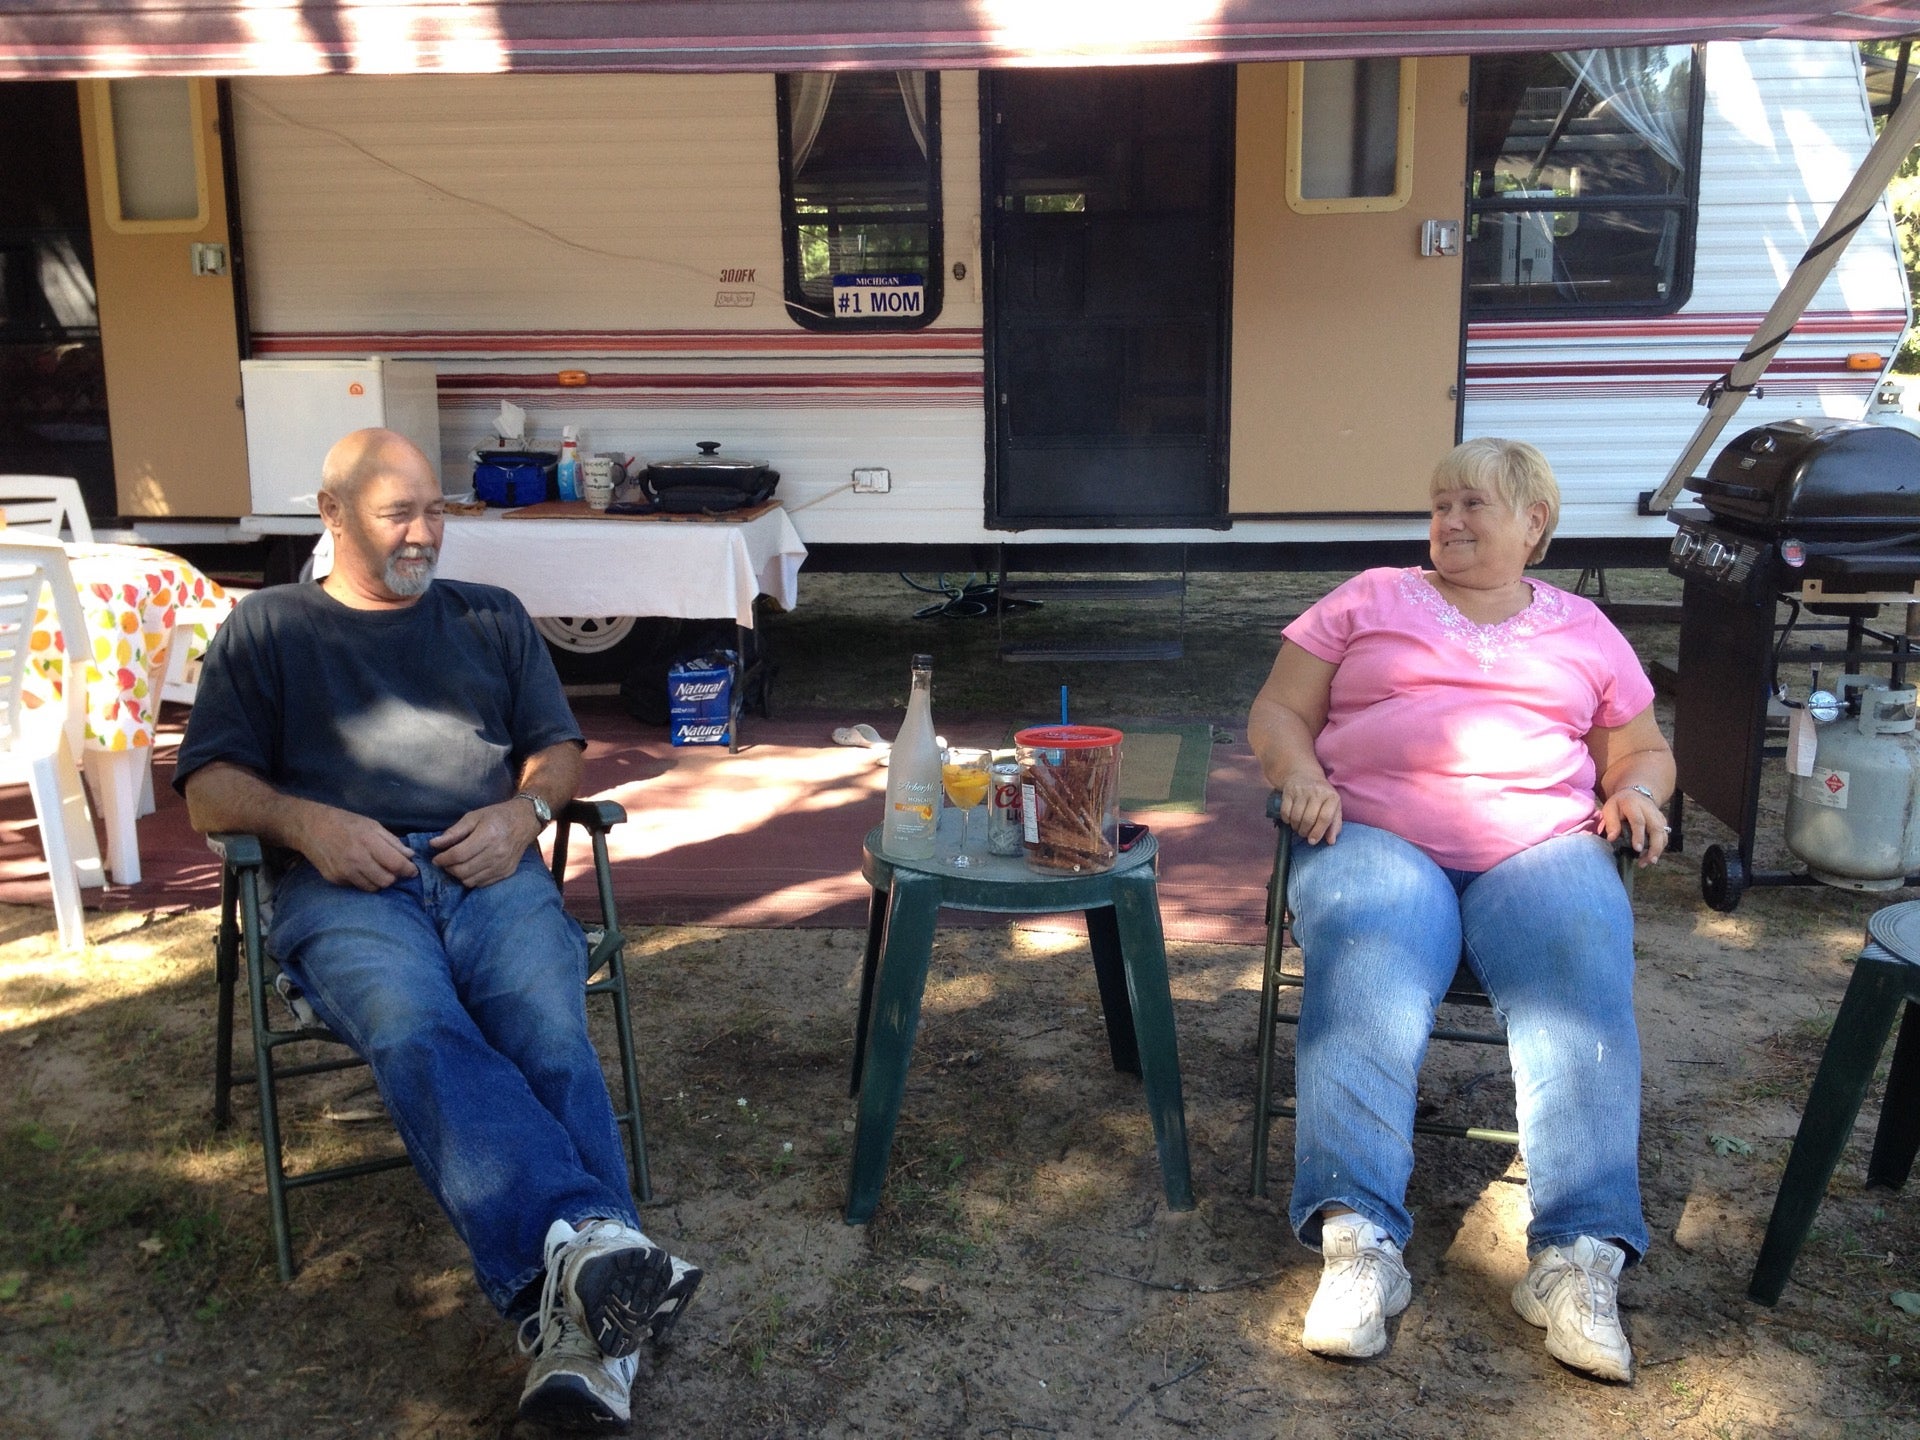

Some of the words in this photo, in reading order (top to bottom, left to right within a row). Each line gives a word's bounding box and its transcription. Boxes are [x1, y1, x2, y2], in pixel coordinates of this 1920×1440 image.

[719, 268, 756, 283] 300FK
[855, 277, 900, 286] MICHIGAN
[838, 292, 862, 313] #1
[870, 291, 920, 312] MOM
[675, 680, 726, 696] Natural
[677, 723, 729, 737] Natural
